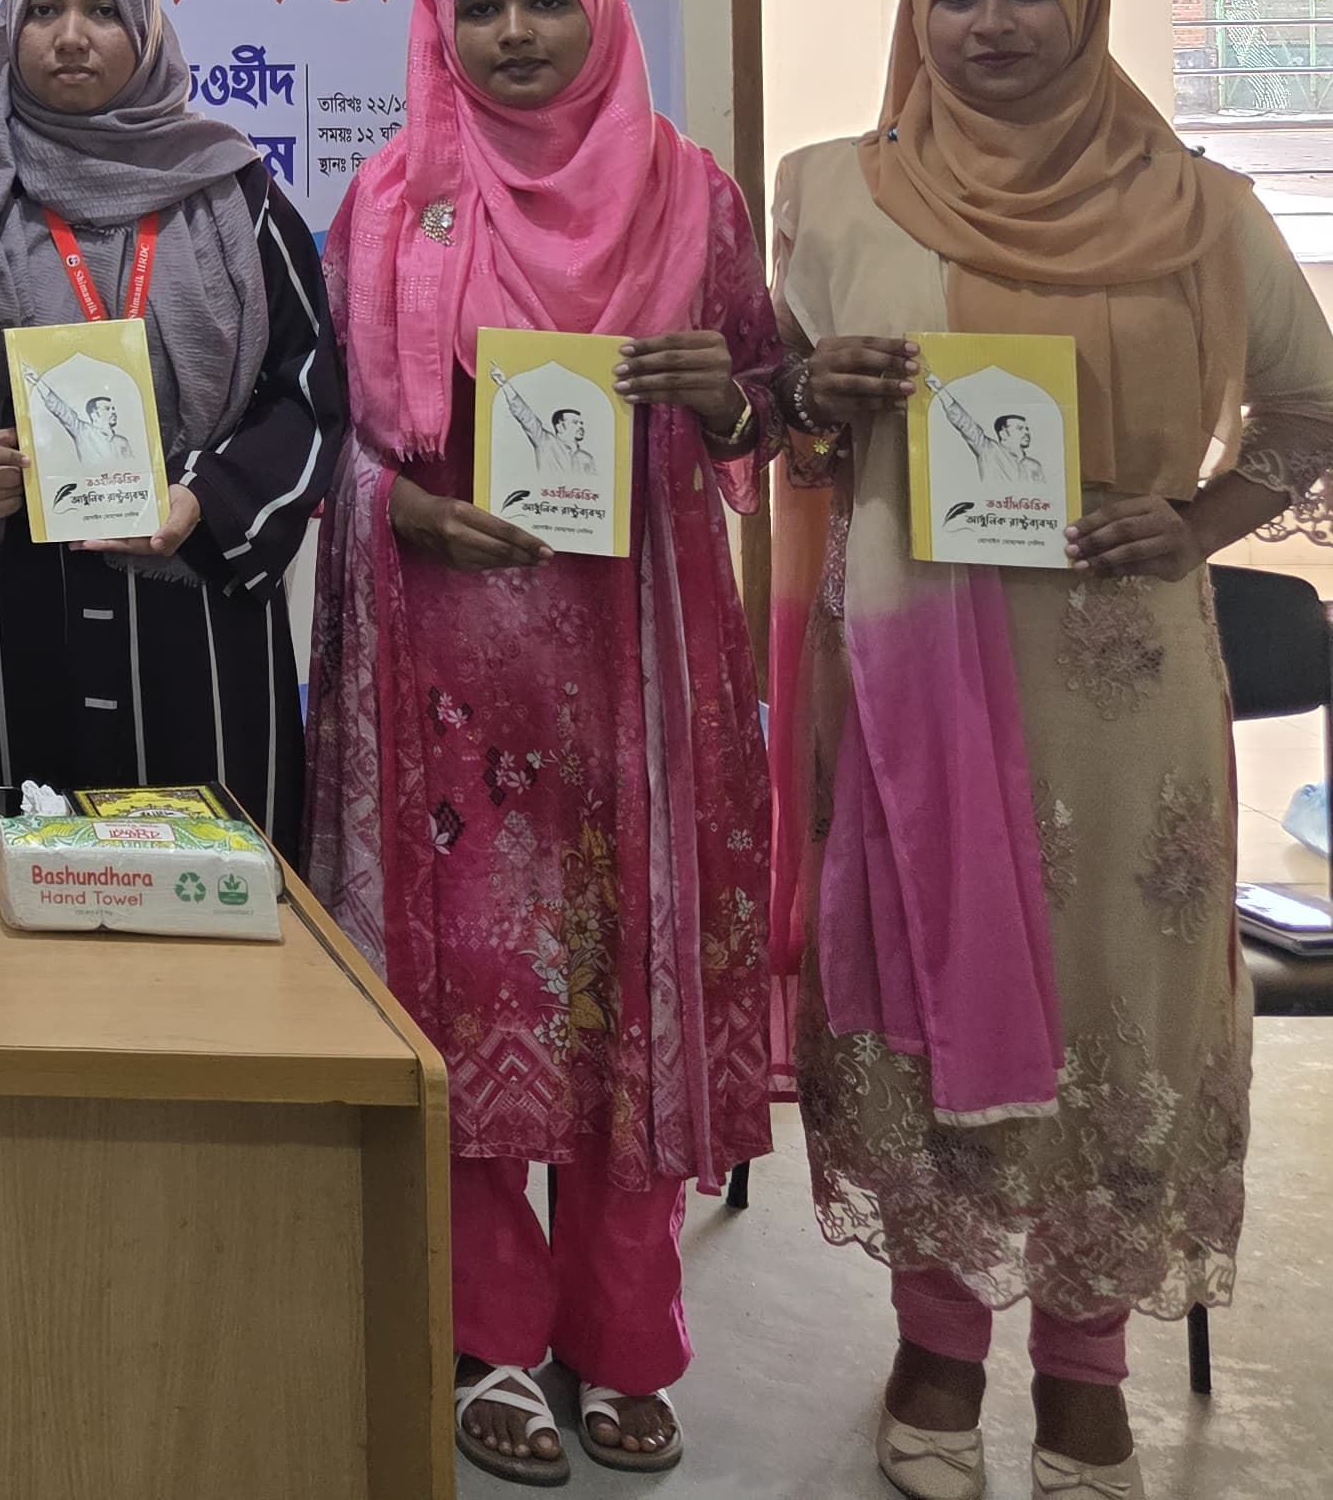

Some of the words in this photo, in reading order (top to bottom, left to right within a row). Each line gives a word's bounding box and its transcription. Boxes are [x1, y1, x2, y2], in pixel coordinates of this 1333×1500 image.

[357, 127, 375, 144] ১২
[31, 864, 153, 887] Bashundhara
[41, 890, 86, 906] Hand
[93, 891, 143, 907] Towel
